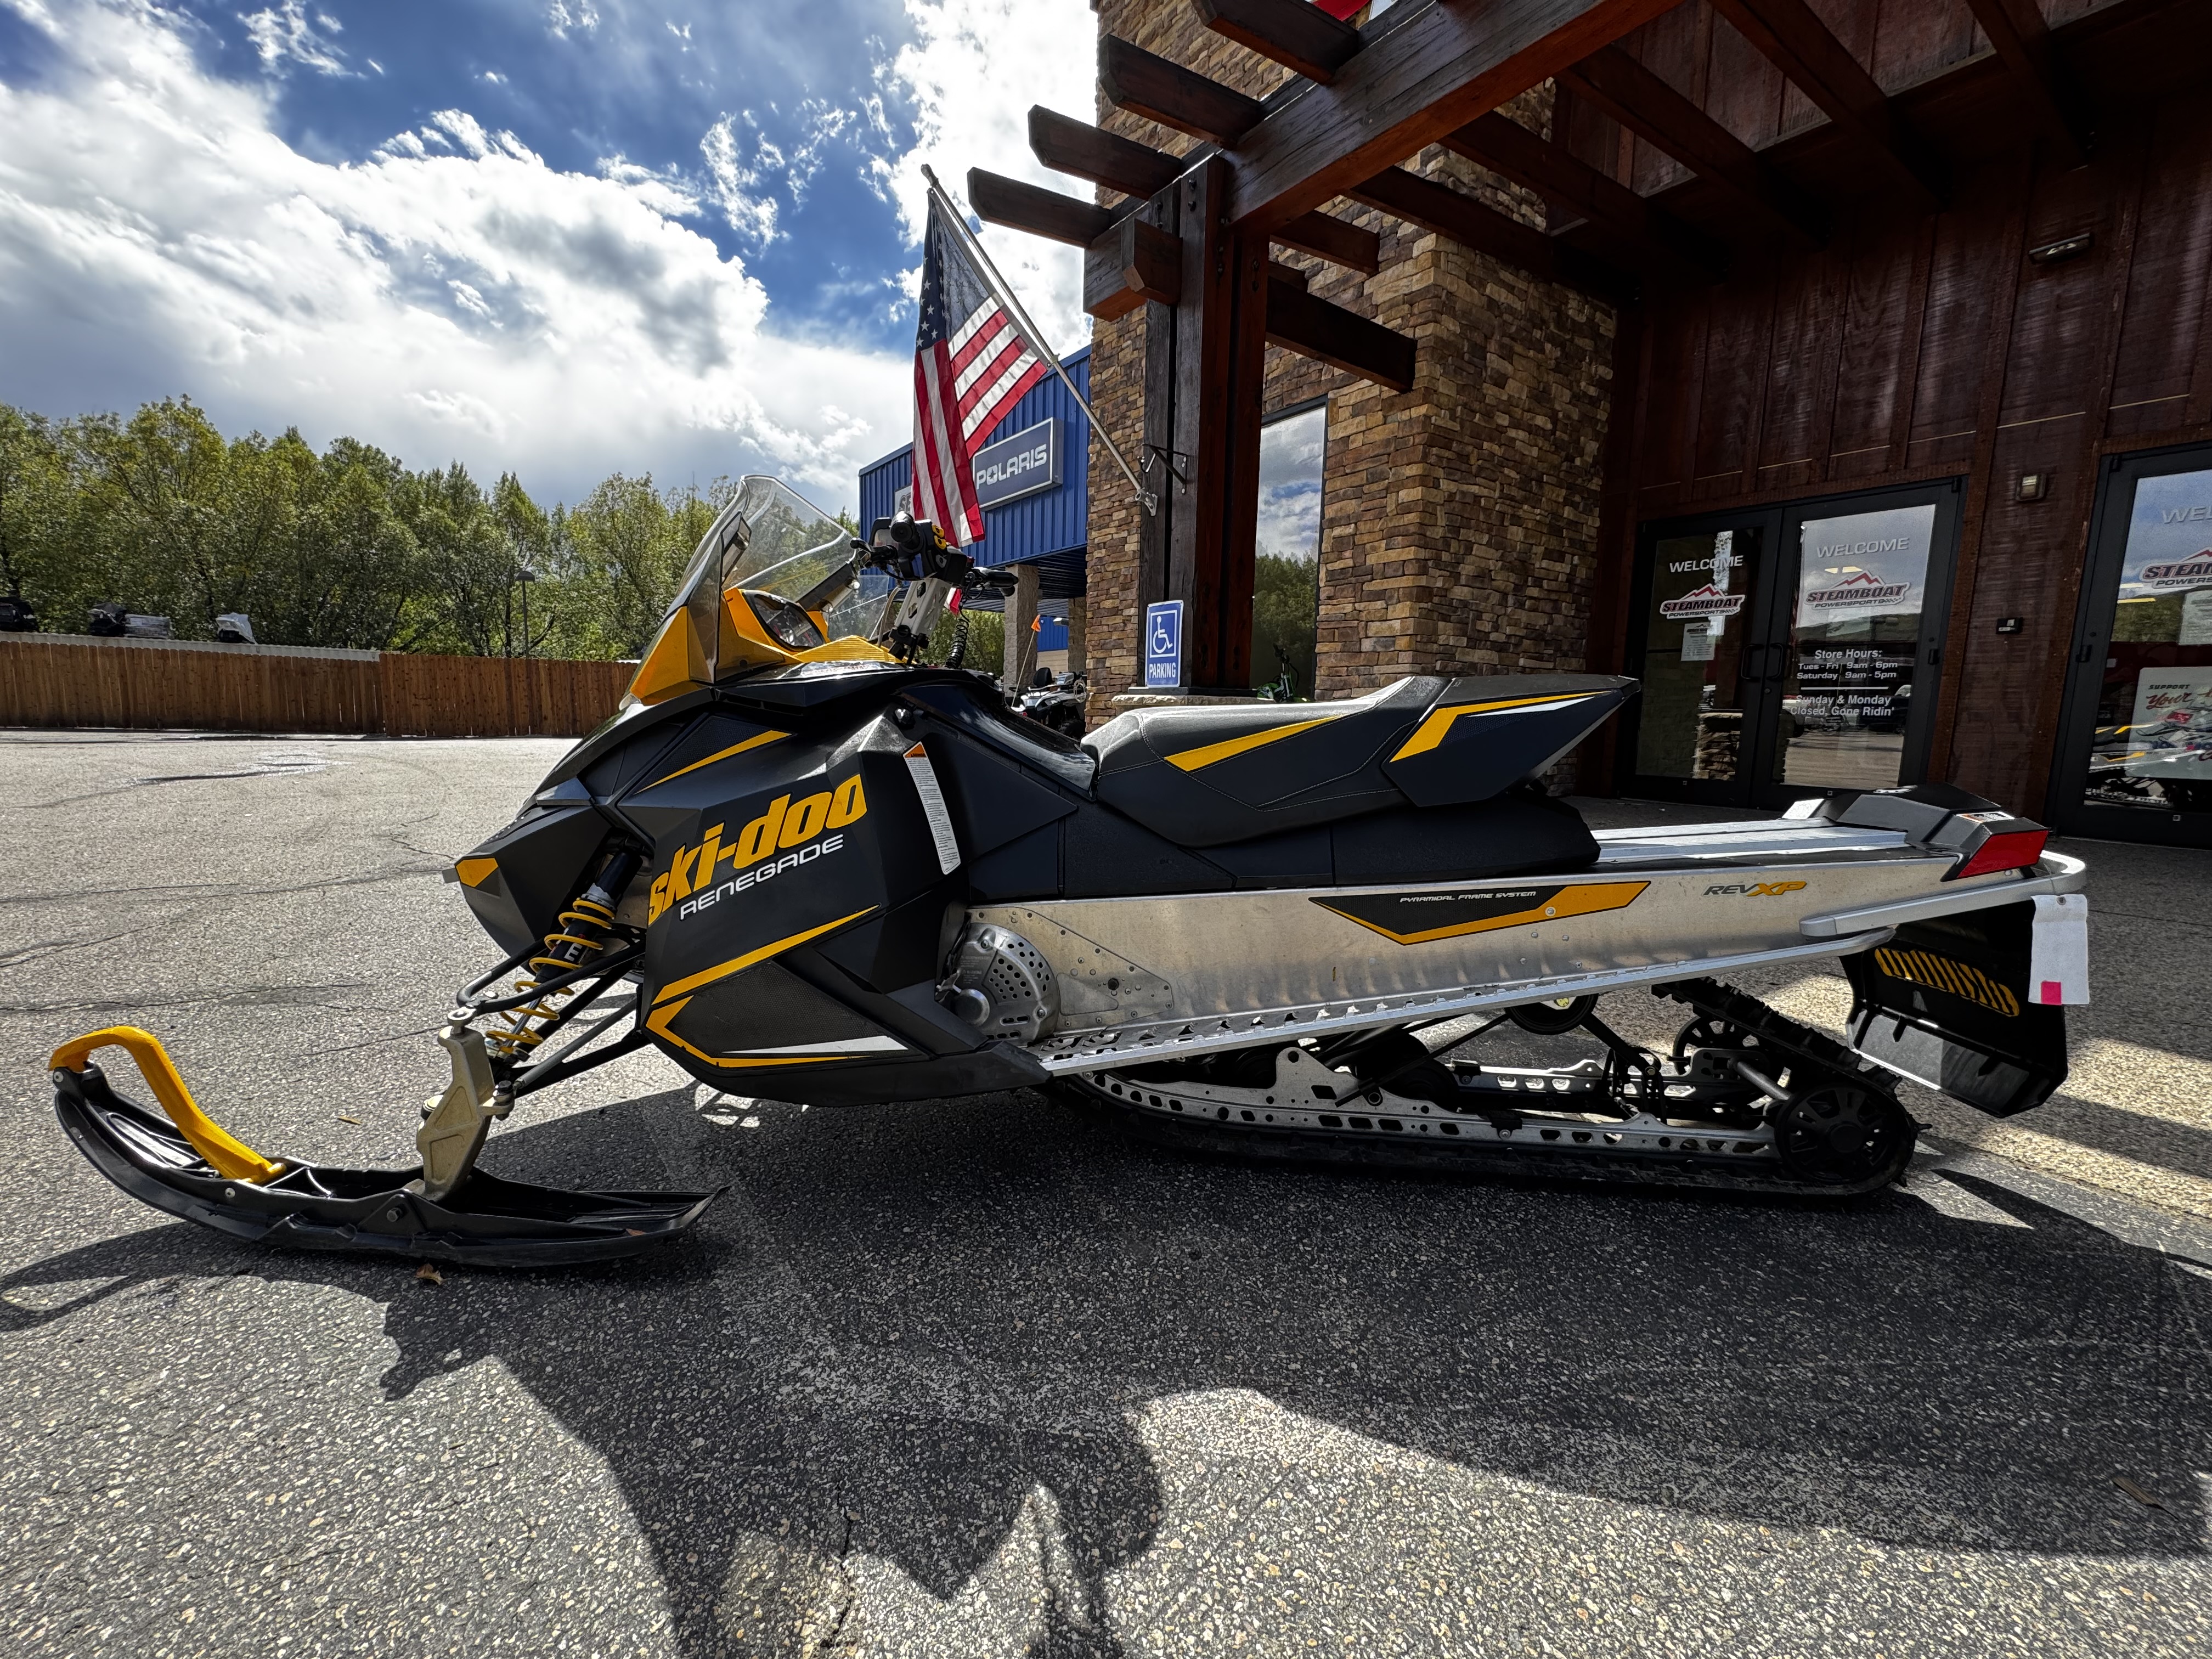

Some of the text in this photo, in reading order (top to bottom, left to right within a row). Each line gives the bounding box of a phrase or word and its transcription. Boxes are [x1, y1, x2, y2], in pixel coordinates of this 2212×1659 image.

[977, 444, 1047, 490] POLARIS
[1817, 538, 1910, 558] WELCOME
[1669, 555, 1743, 573] WELCOME
[1807, 585, 1908, 602] STEAMBOAT
[1662, 597, 1742, 612] STEAMBOAT
[1815, 599, 1885, 608] POWERSPORTS
[1815, 649, 1883, 659] Store Hours:
[1149, 662, 1176, 679] PARKING
[1797, 672, 1838, 680] Saturday
[1874, 671, 1897, 679] 5pm
[1796, 695, 1891, 706] Sunday & Monday
[2146, 692, 2194, 709] Your
[1831, 707, 1860, 715] Gone
[1863, 706, 1895, 716] Ridin'
[648, 774, 867, 926] ski-doo
[680, 834, 844, 921] RENEGADE
[1400, 895, 1455, 903] PYRAMIDAL
